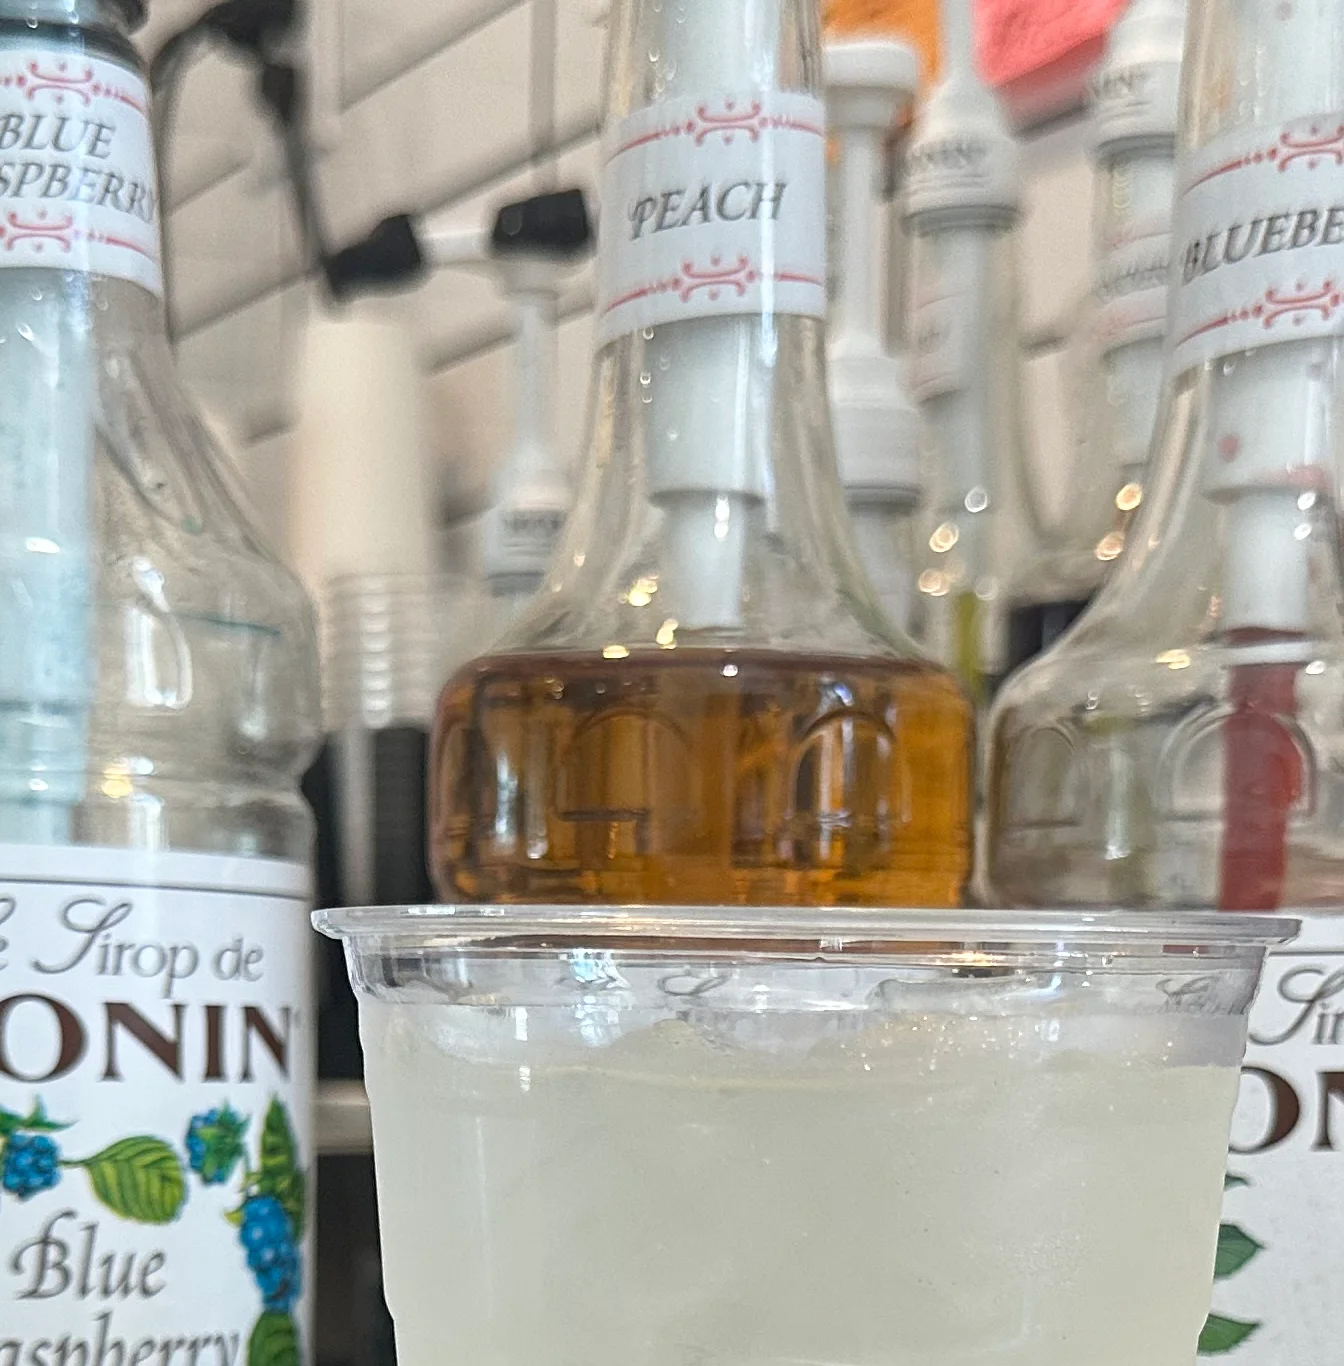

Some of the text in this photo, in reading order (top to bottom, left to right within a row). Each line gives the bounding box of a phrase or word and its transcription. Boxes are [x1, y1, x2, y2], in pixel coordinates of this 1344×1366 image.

[628, 181, 787, 240] PEACH
[34, 898, 198, 996] Sirop
[213, 936, 263, 982] de
[11, 1210, 167, 1299] Blue
